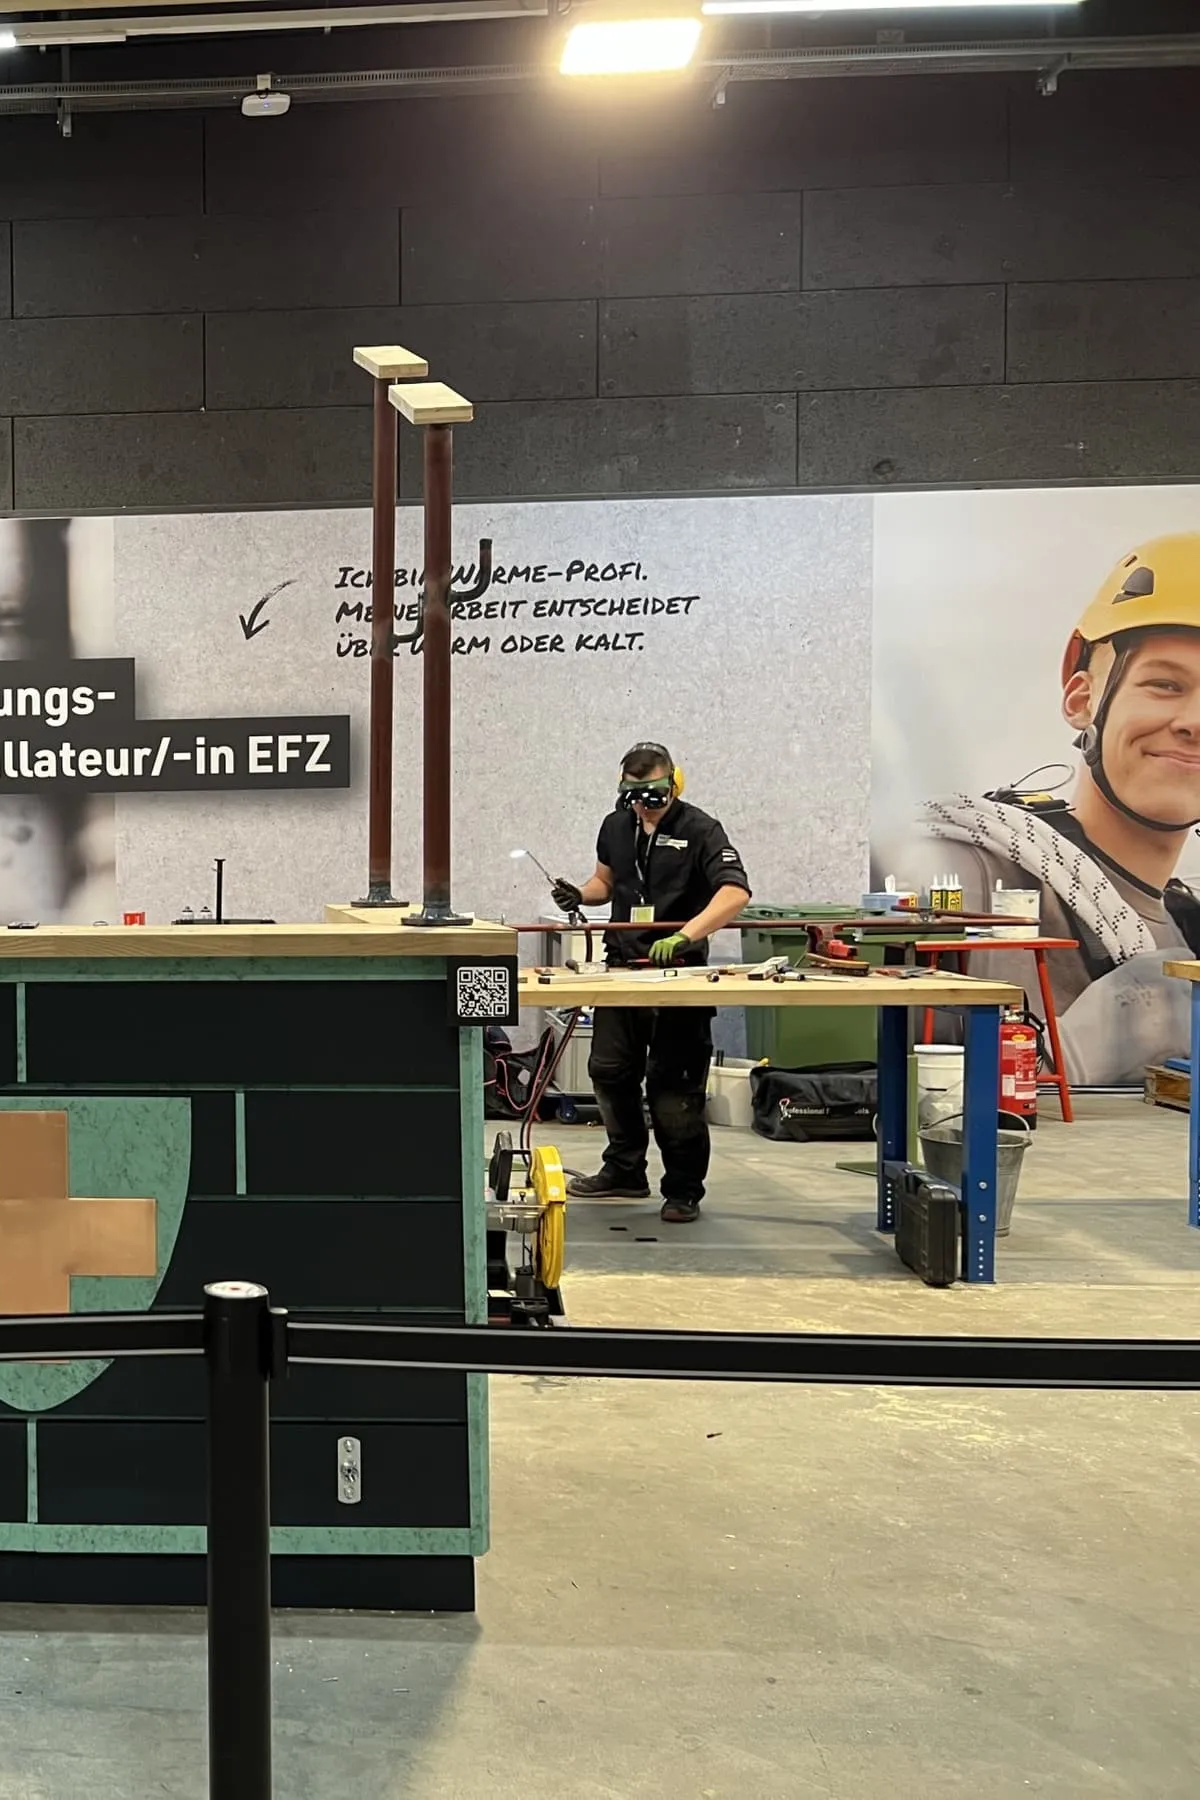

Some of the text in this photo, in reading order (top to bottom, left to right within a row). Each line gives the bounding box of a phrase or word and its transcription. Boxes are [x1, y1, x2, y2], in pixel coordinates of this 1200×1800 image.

[335, 595, 700, 624] MENE RBEIT ENTSCHEIDET
[500, 633, 566, 654] ODER
[574, 632, 645, 653] KALT.
[247, 733, 332, 775] EFZ
